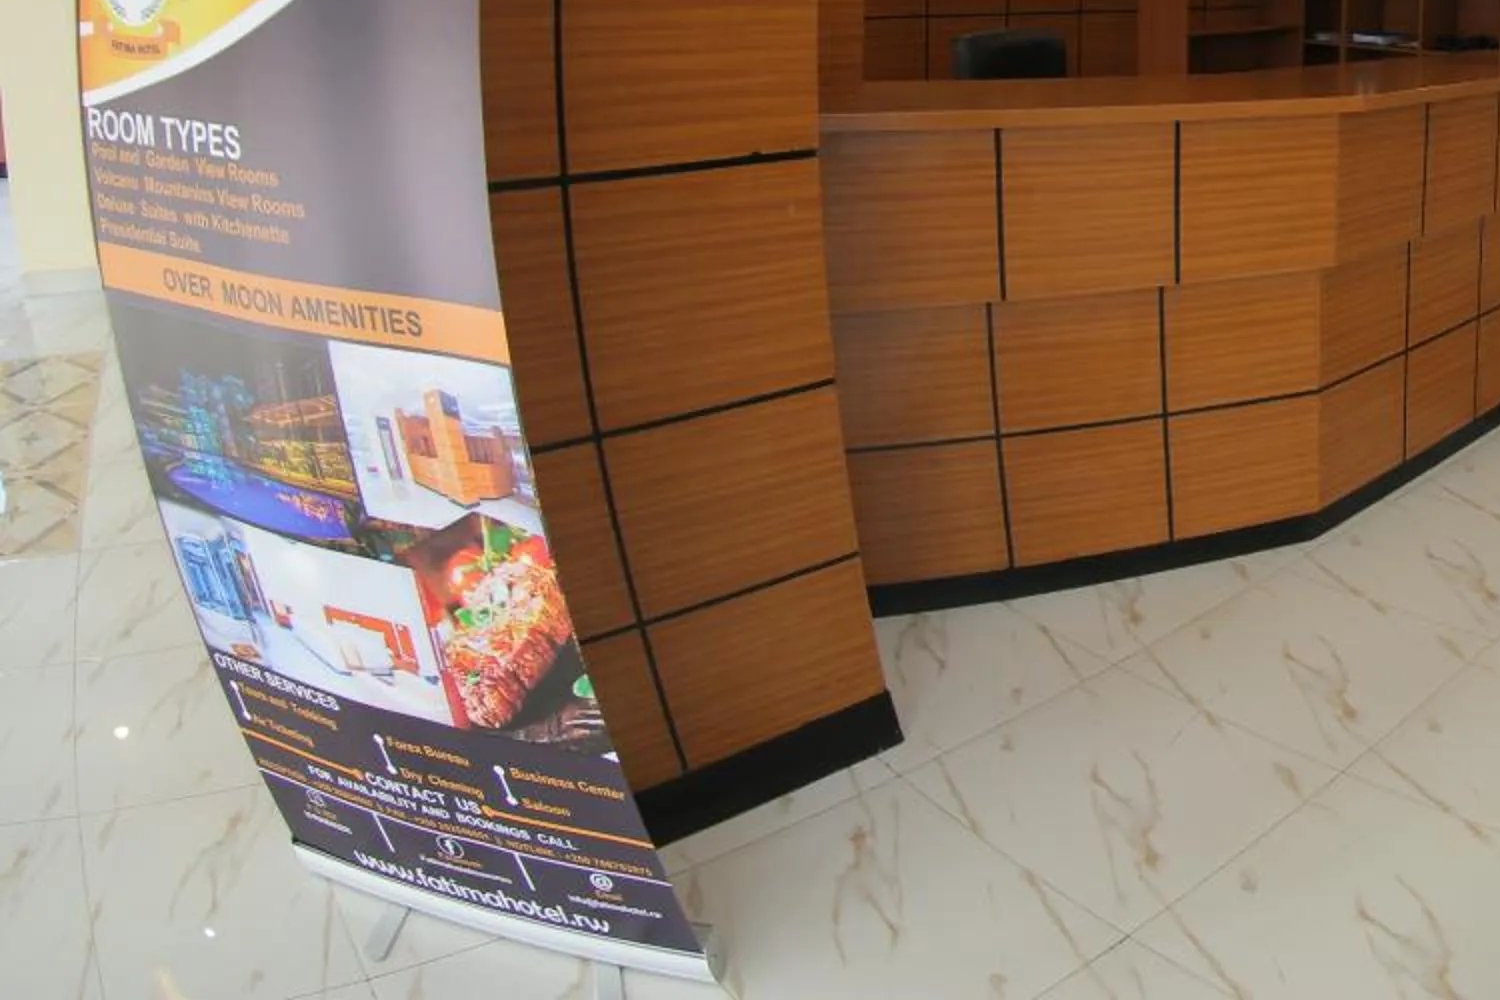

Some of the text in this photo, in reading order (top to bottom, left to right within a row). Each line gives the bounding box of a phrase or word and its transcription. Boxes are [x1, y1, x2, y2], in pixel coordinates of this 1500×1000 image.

[87, 107, 242, 161] ROOM TYPES
[144, 150, 190, 173] Garden
[227, 162, 280, 188] Rooms
[182, 211, 210, 229] with
[215, 186, 250, 213] View
[251, 193, 305, 219] Rooms
[162, 267, 423, 338] OVER MOON AMENITIES
[213, 652, 340, 711] OTHER SERVICES
[386, 735, 424, 756] Forex
[364, 771, 445, 805] CONTACT
[454, 795, 482, 816] US
[399, 767, 423, 785] Dry
[509, 767, 625, 802] Business Center
[307, 763, 334, 783] FOR
[421, 804, 451, 820] AND
[455, 811, 532, 841] BOOKINGS
[536, 832, 581, 852] CALL
